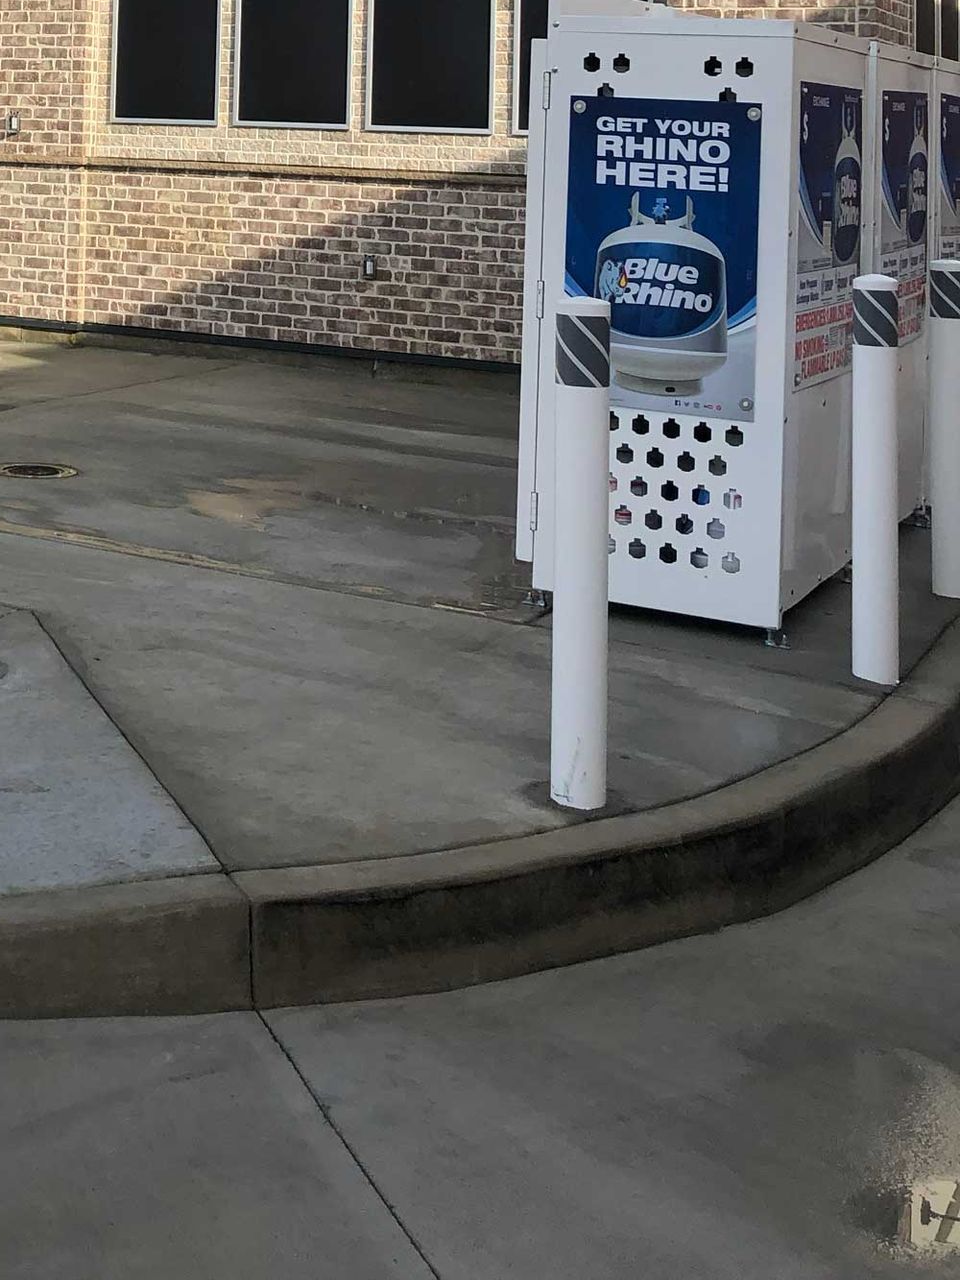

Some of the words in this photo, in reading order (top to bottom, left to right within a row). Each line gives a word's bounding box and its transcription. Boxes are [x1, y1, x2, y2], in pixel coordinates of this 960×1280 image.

[595, 116, 649, 133] GET
[654, 118, 731, 138] YOUR
[596, 134, 731, 165] RHINO
[595, 159, 730, 193] HERE!
[840, 174, 858, 198] Blue
[624, 258, 700, 285] Blue
[614, 282, 713, 313] Rhino
